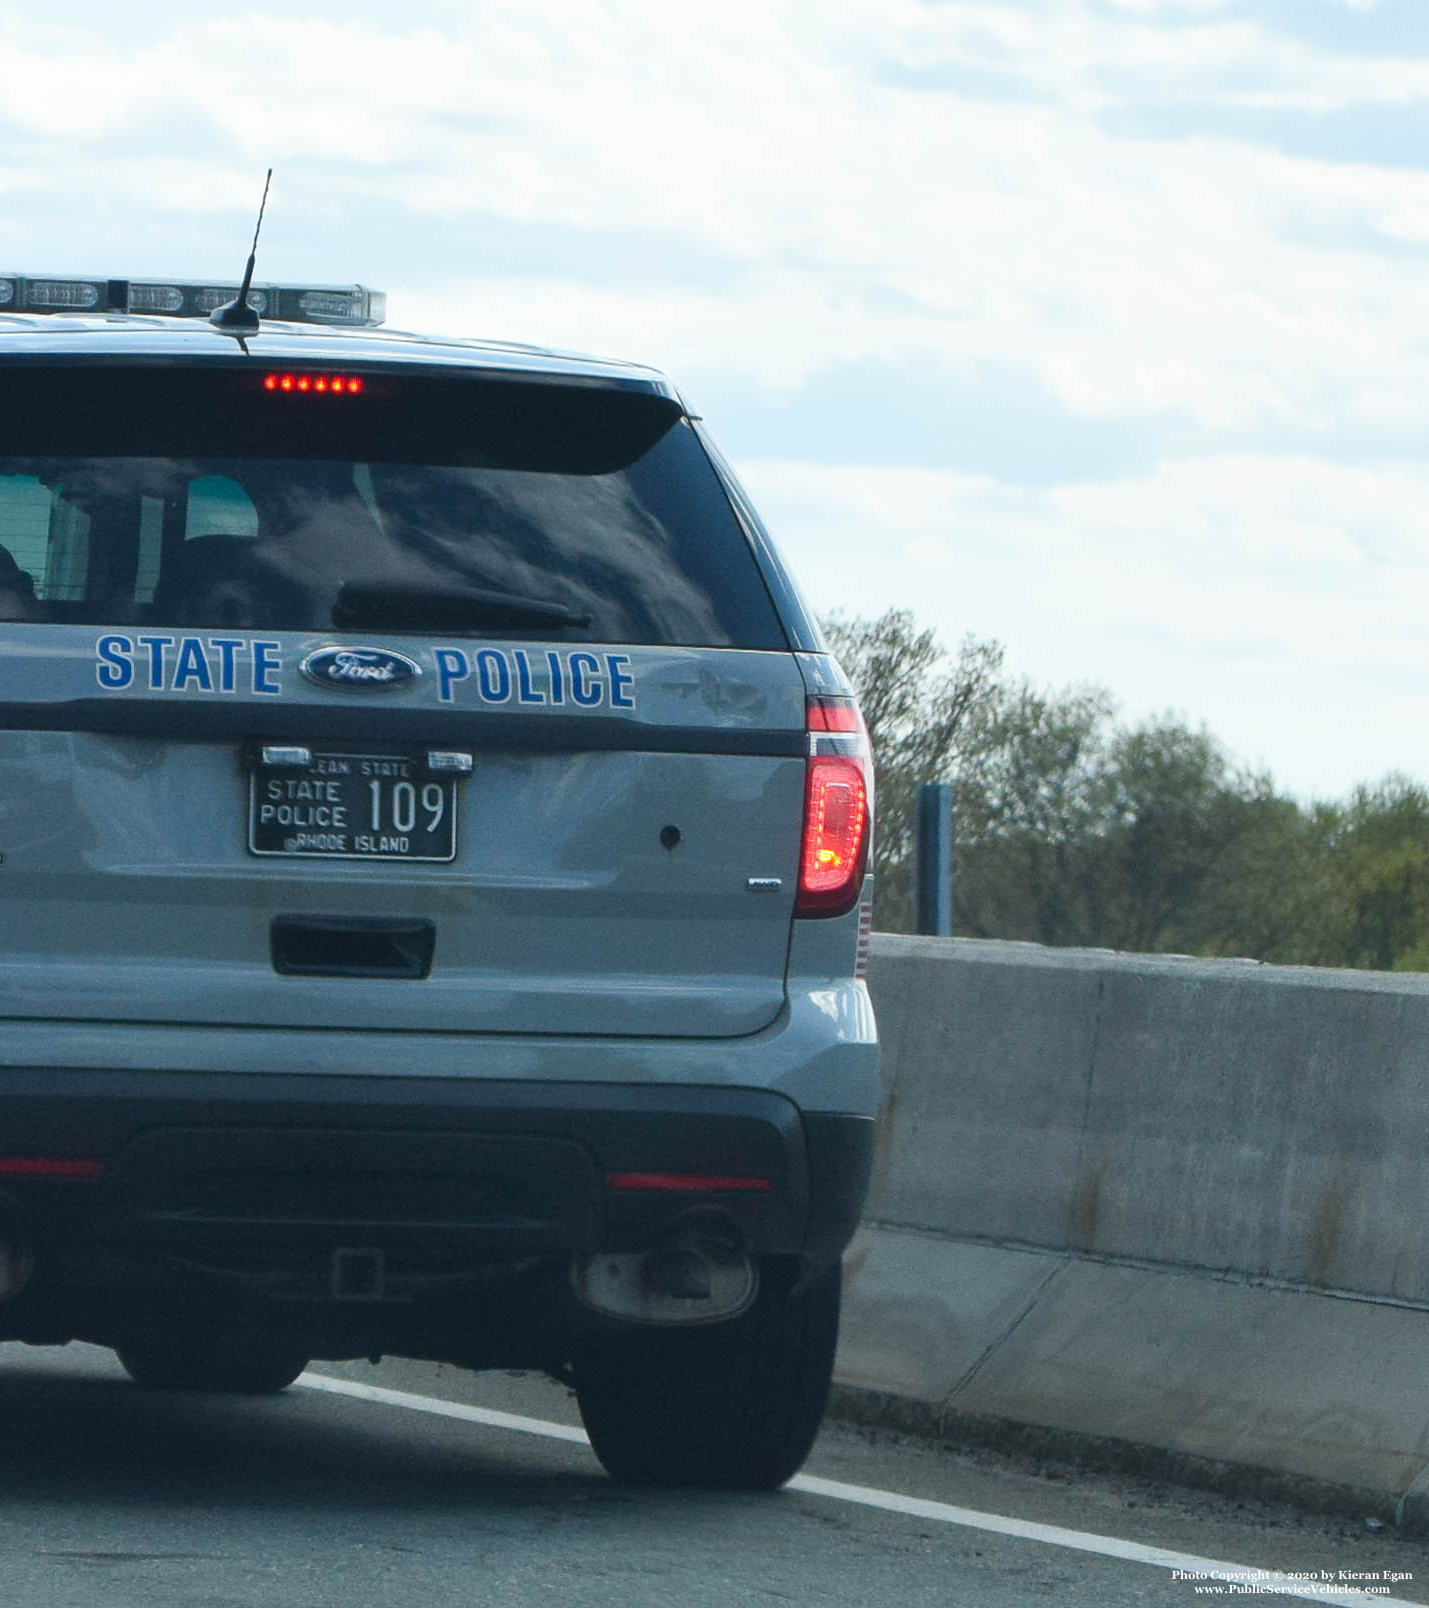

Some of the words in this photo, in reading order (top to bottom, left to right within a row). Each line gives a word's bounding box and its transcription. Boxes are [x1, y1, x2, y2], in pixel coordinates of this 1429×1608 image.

[96, 633, 284, 696] STATE
[431, 646, 637, 710] POLICE
[328, 651, 395, 680] Ford
[309, 759, 350, 774] EAN
[361, 761, 410, 777] STATE
[267, 780, 341, 802] STATE
[260, 804, 348, 828] POLICE
[369, 780, 444, 833] 109
[297, 832, 347, 851] RHODE
[355, 835, 410, 853] ISLAND
